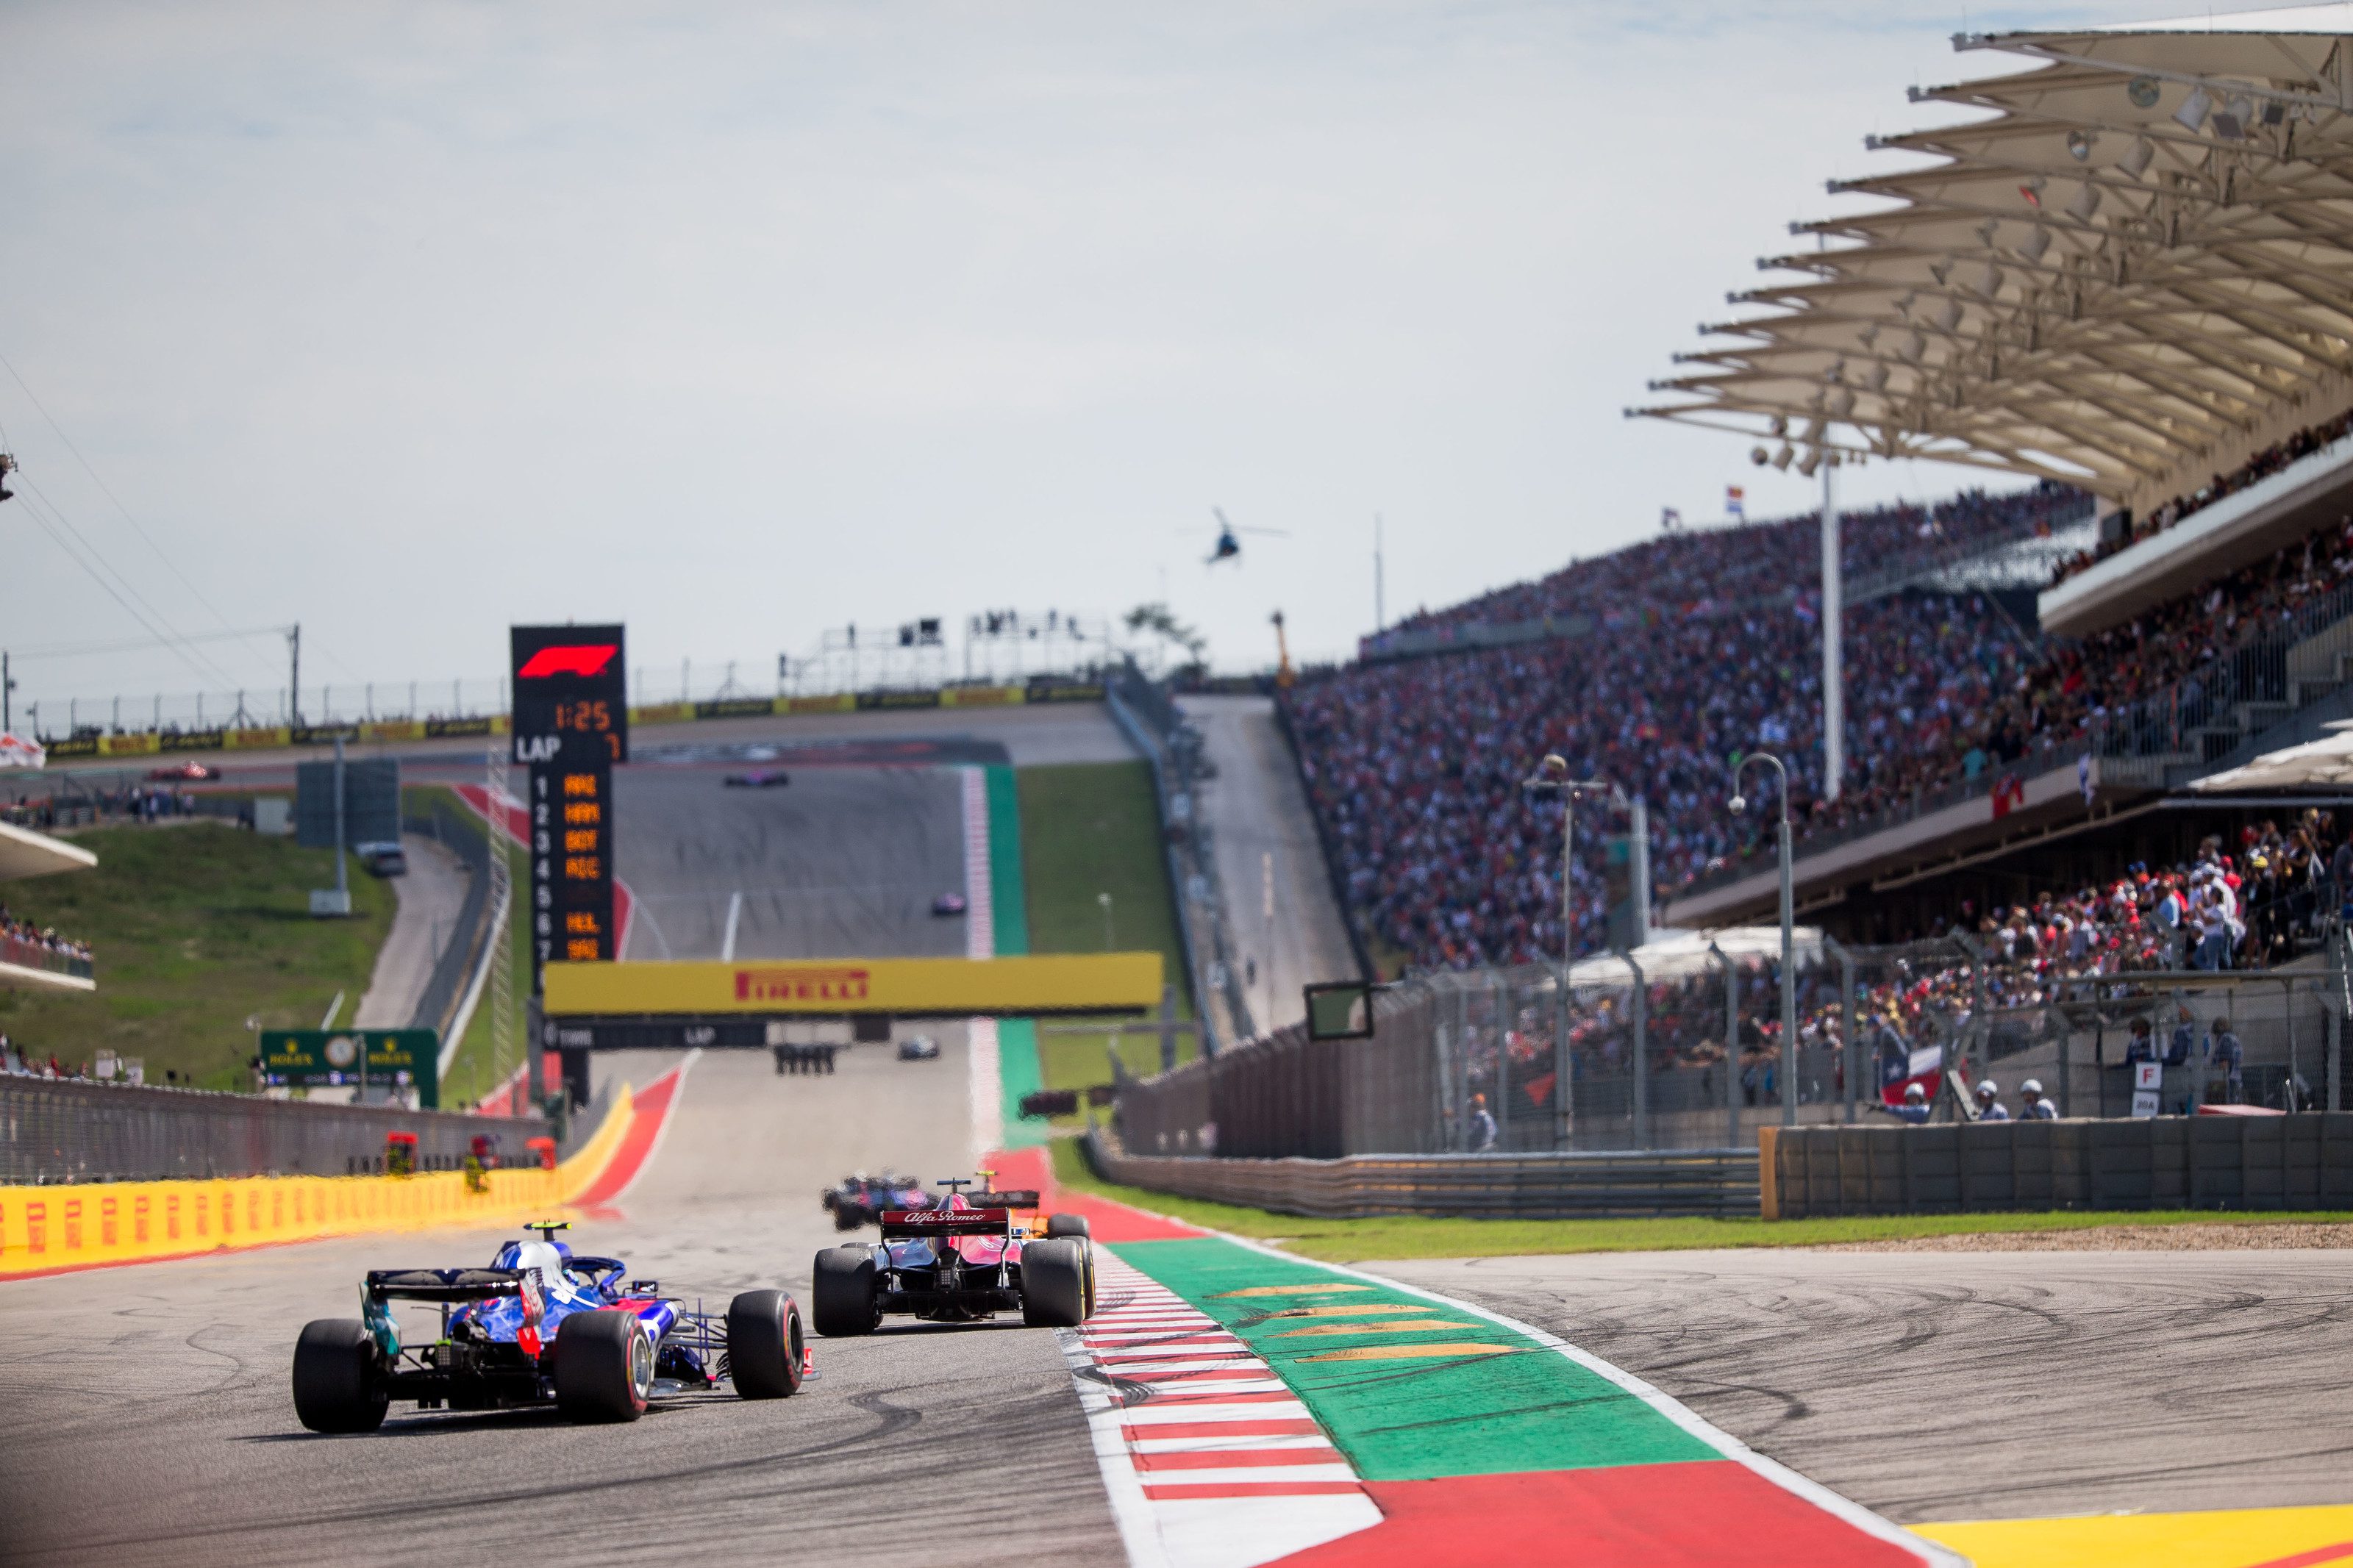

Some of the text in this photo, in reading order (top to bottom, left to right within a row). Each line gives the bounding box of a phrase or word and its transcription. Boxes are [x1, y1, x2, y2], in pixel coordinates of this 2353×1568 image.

[556, 700, 611, 731] 1:25
[516, 736, 562, 761] LAP
[537, 776, 548, 798] 1
[536, 803, 550, 825] 2
[536, 831, 551, 853] 3
[537, 858, 551, 879] 4
[735, 968, 870, 1000] PIRELLI
[684, 1027, 715, 1045] LAP
[2142, 1067, 2154, 1084] F
[904, 1210, 985, 1225] Alfa Romeo
